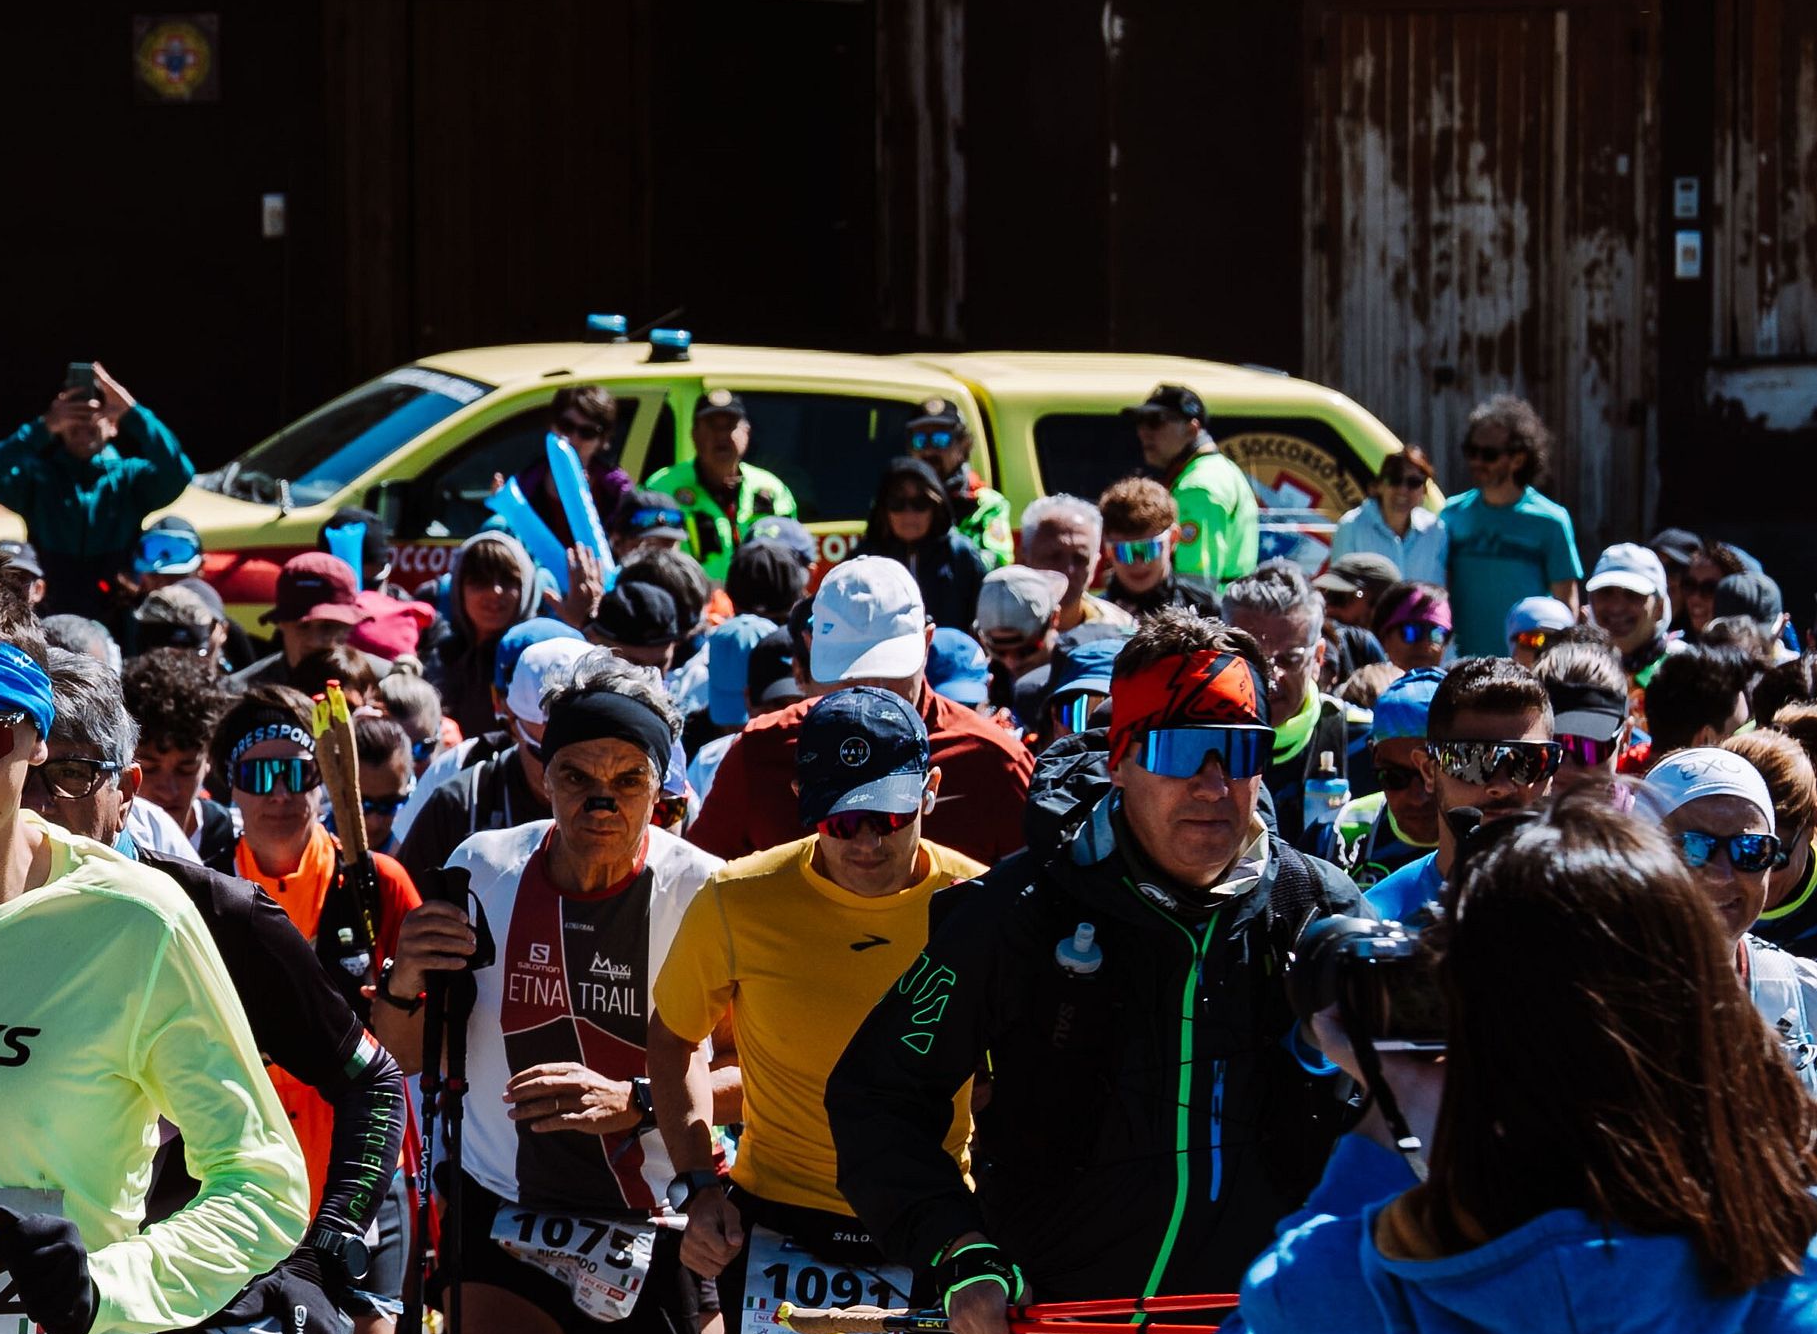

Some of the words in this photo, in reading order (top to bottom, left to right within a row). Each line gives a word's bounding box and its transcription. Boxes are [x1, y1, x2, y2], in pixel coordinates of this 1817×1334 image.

[509, 973, 565, 1008] ETNA
[578, 982, 641, 1017] TRAIL
[512, 1213, 637, 1269] 1075
[833, 1233, 872, 1243] SALO
[763, 1264, 894, 1308] 1091
[917, 1320, 944, 1328] LEKI
